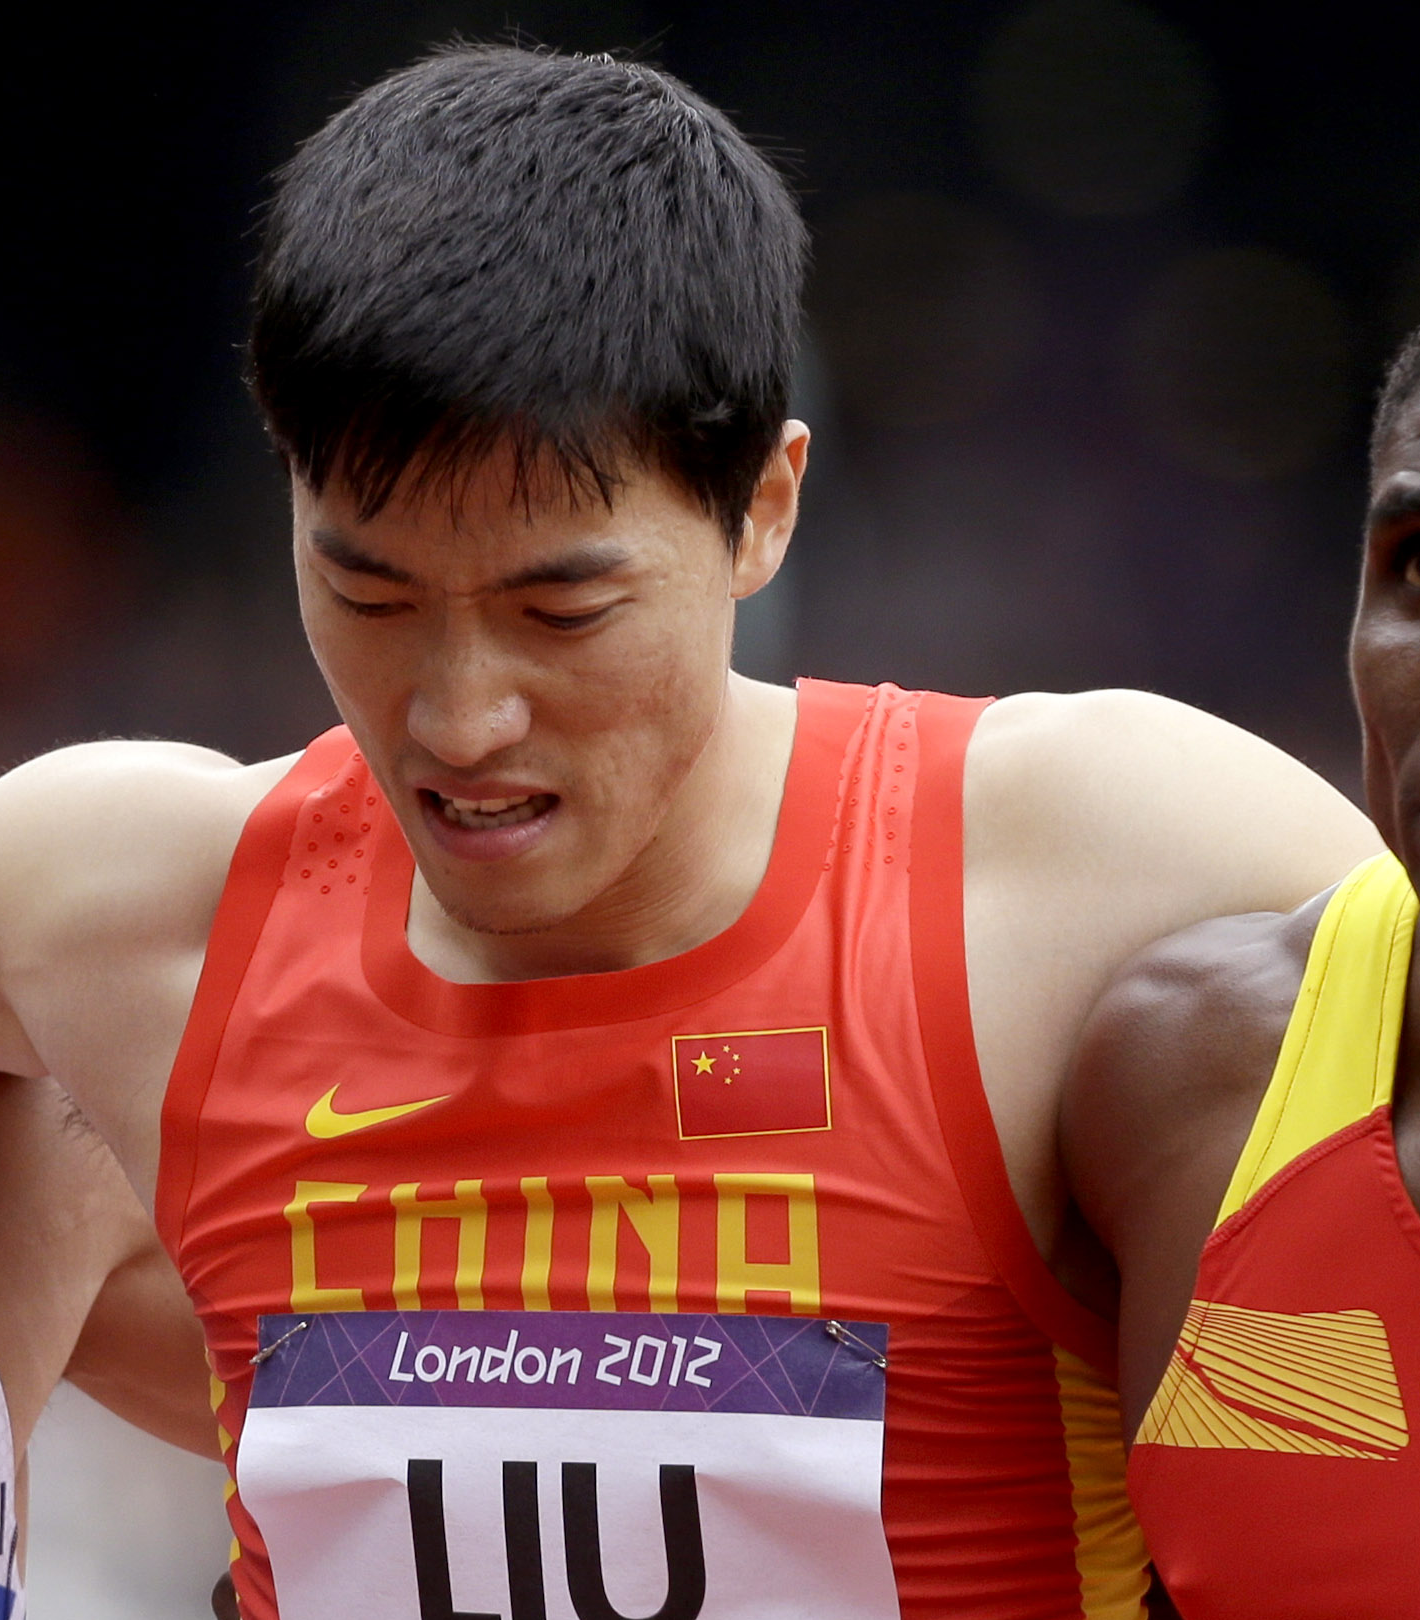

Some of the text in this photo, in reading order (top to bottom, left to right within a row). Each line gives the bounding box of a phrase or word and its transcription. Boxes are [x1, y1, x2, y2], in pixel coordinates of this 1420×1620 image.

[283, 1173, 822, 1313] CHINA
[389, 1330, 722, 1388] London 2012
